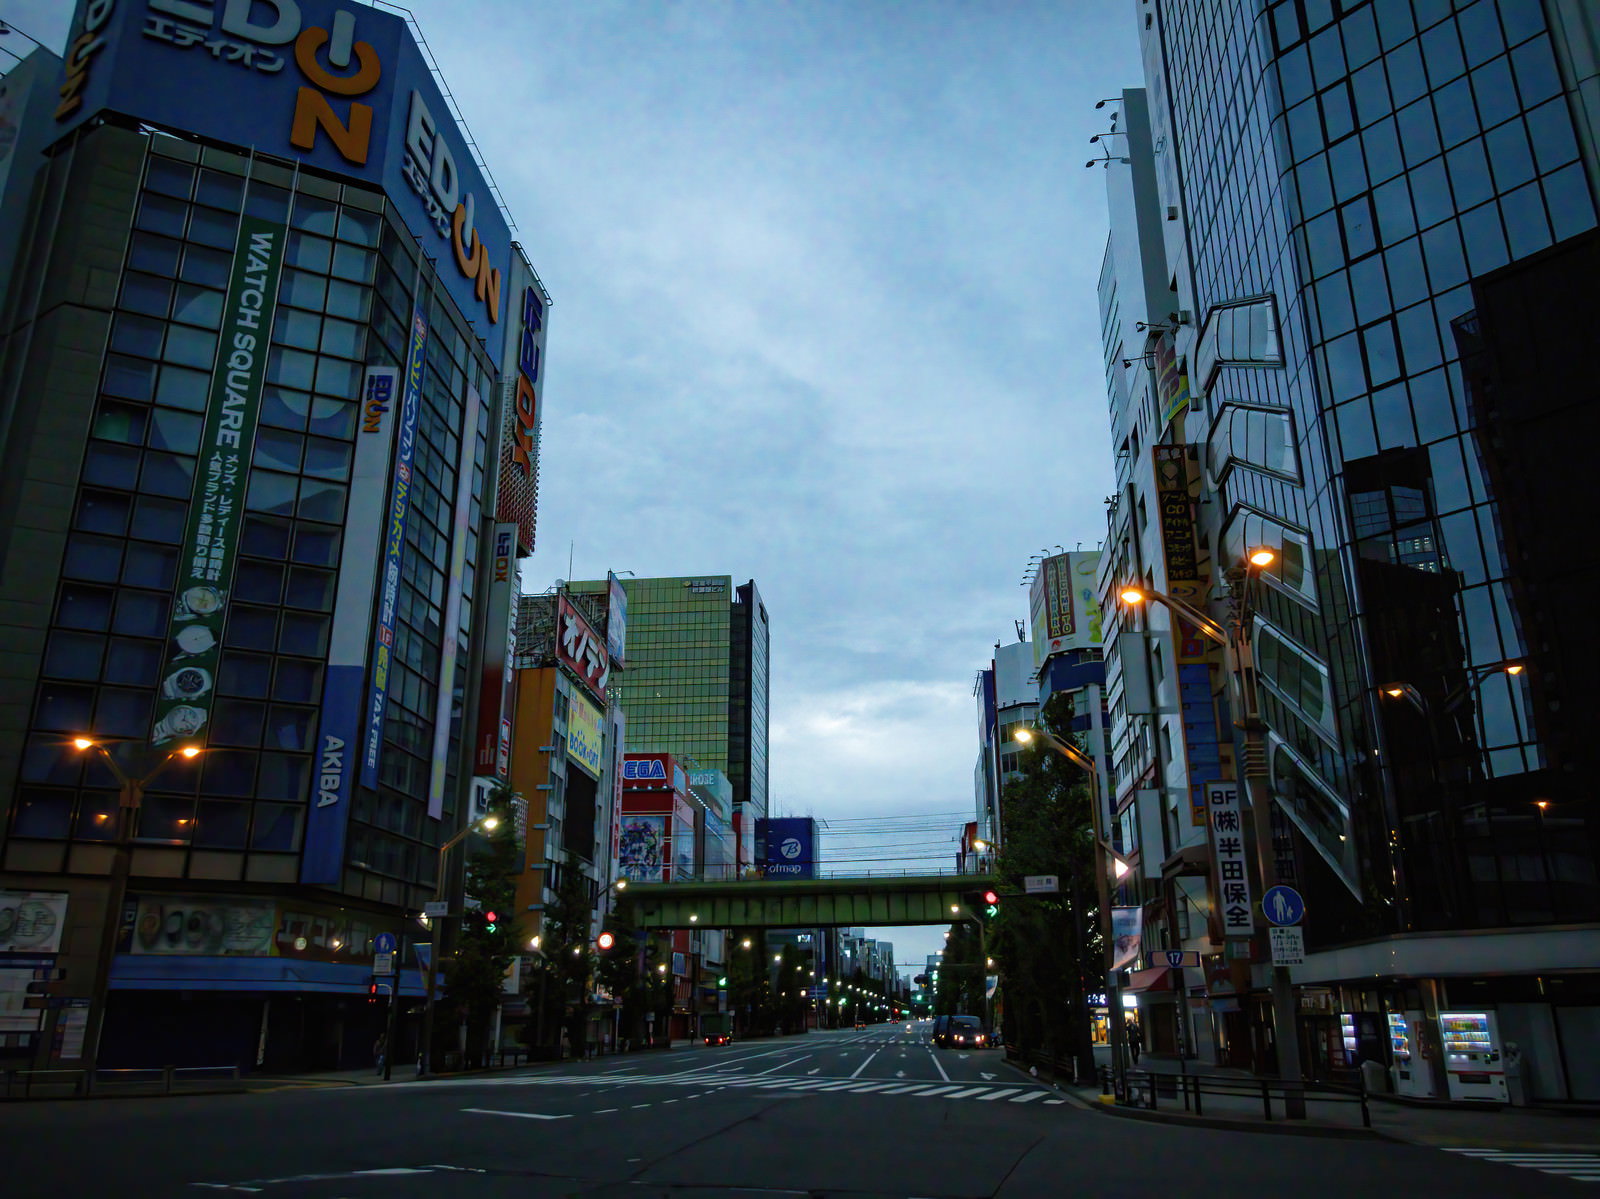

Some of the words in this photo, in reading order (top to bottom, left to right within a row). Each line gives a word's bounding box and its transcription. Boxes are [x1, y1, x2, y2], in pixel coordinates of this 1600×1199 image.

[142, 15, 285, 73] エディオン
[406, 90, 500, 324] EDION
[236, 231, 274, 330] WATCH
[215, 333, 257, 449] SQUARE
[362, 374, 393, 433] EDION
[371, 691, 384, 732] TAX
[317, 735, 345, 808] AKIBA
[367, 728, 379, 770] FREE
[624, 760, 667, 779] EGA
[1169, 952, 1181, 964] 17
